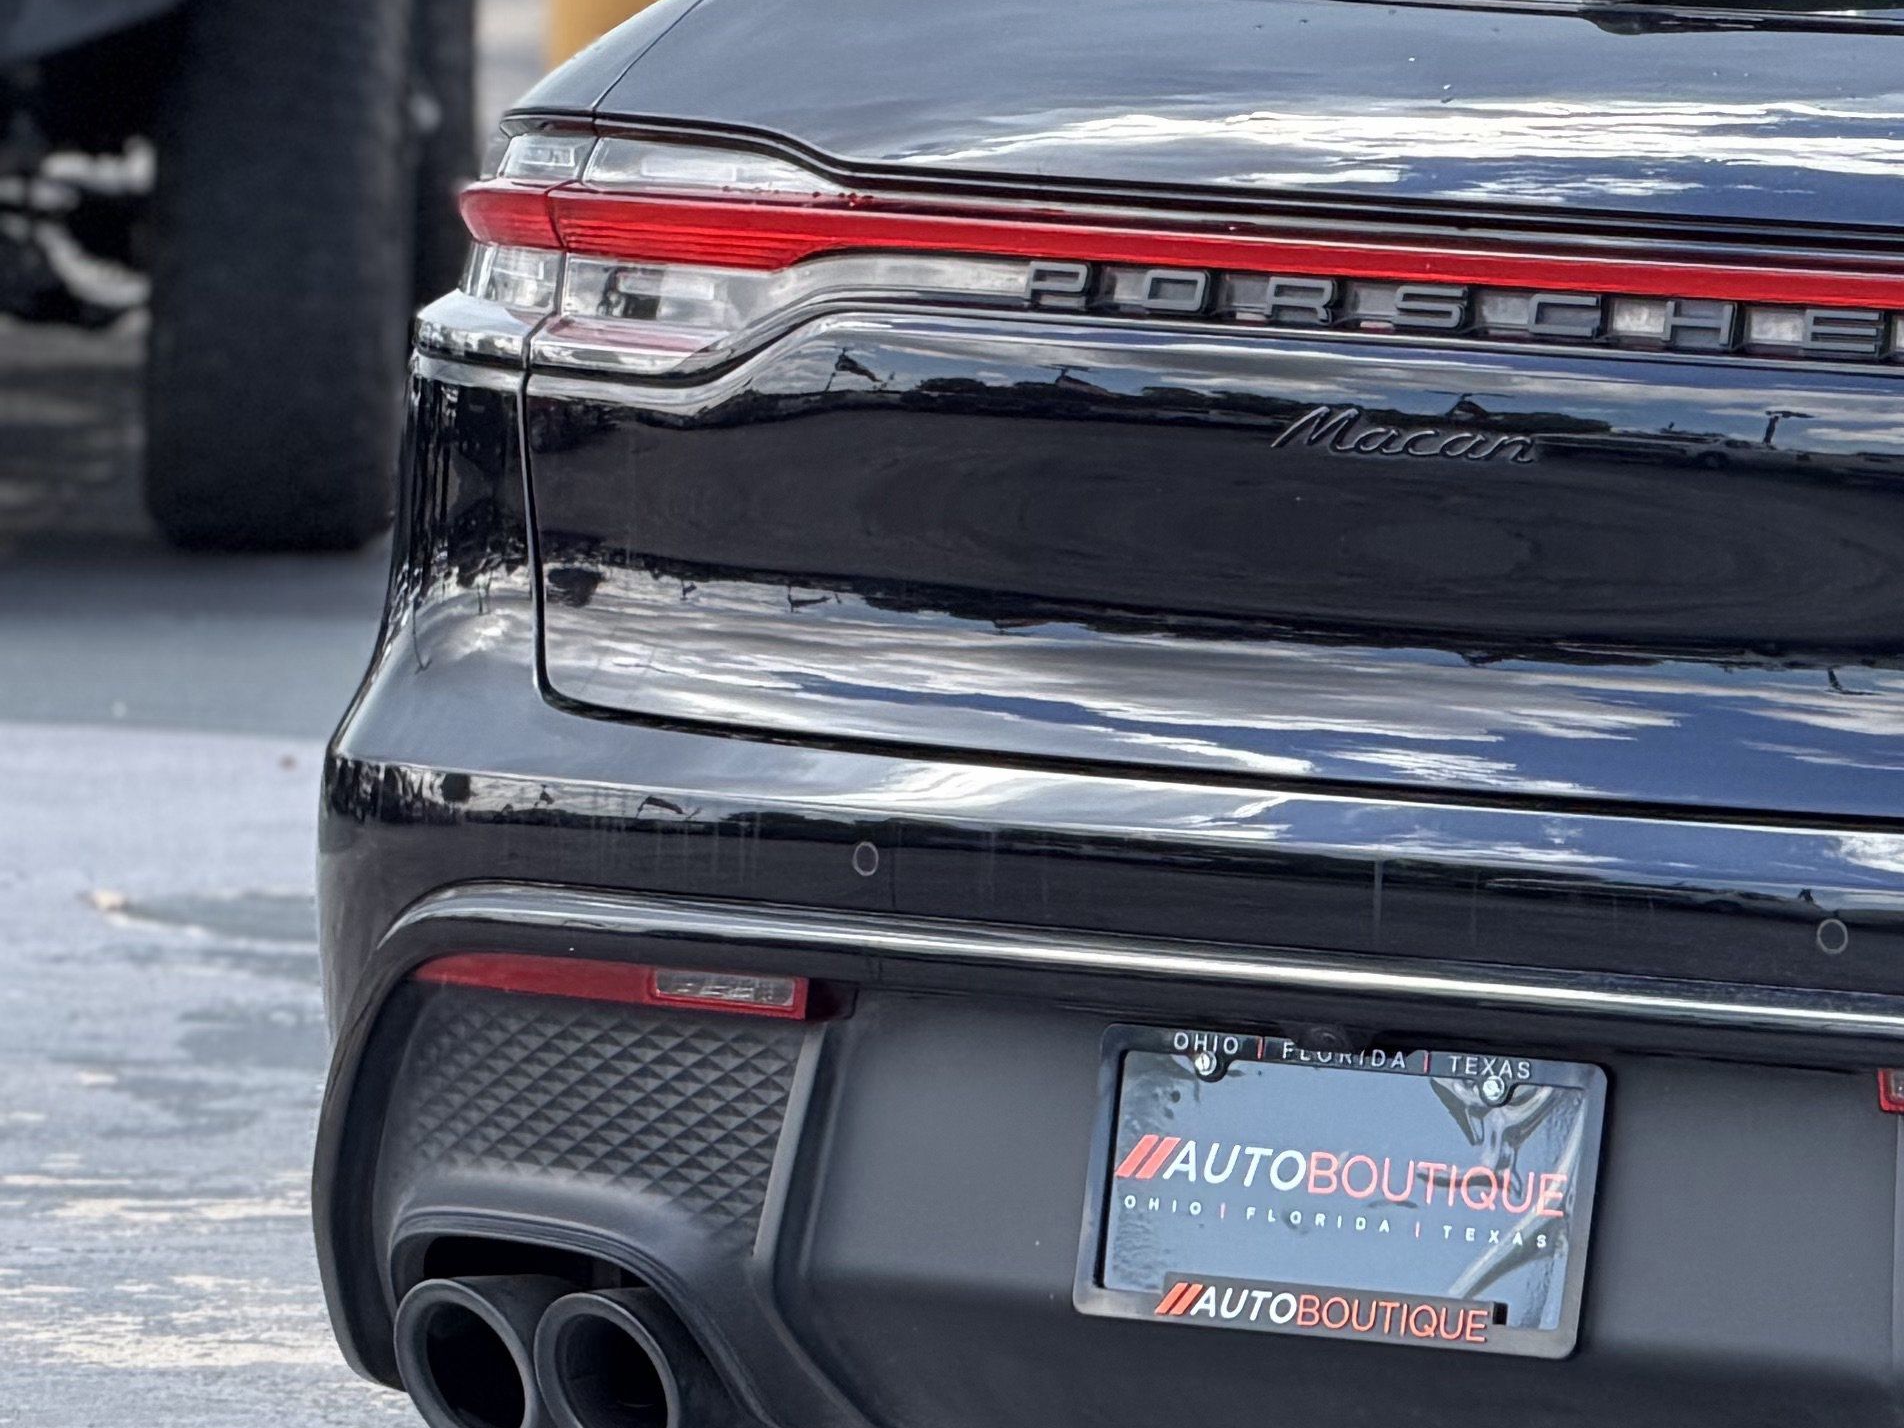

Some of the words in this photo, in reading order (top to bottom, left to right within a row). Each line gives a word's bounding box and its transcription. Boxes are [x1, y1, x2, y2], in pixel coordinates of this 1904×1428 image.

[1022, 261, 1887, 360] PORSCHE
[1271, 406, 1533, 463] Macan
[1173, 1032, 1239, 1055] OHIO
[1450, 1056, 1531, 1079] TEXAS
[1162, 1141, 1567, 1218] AUTOBOUTIQUE
[1125, 1196, 1203, 1216] OHIO
[1247, 1207, 1390, 1234] FLORIDA
[1443, 1225, 1548, 1249] TEXAS
[1190, 1288, 1489, 1343] AUTOBOUTIQUE
